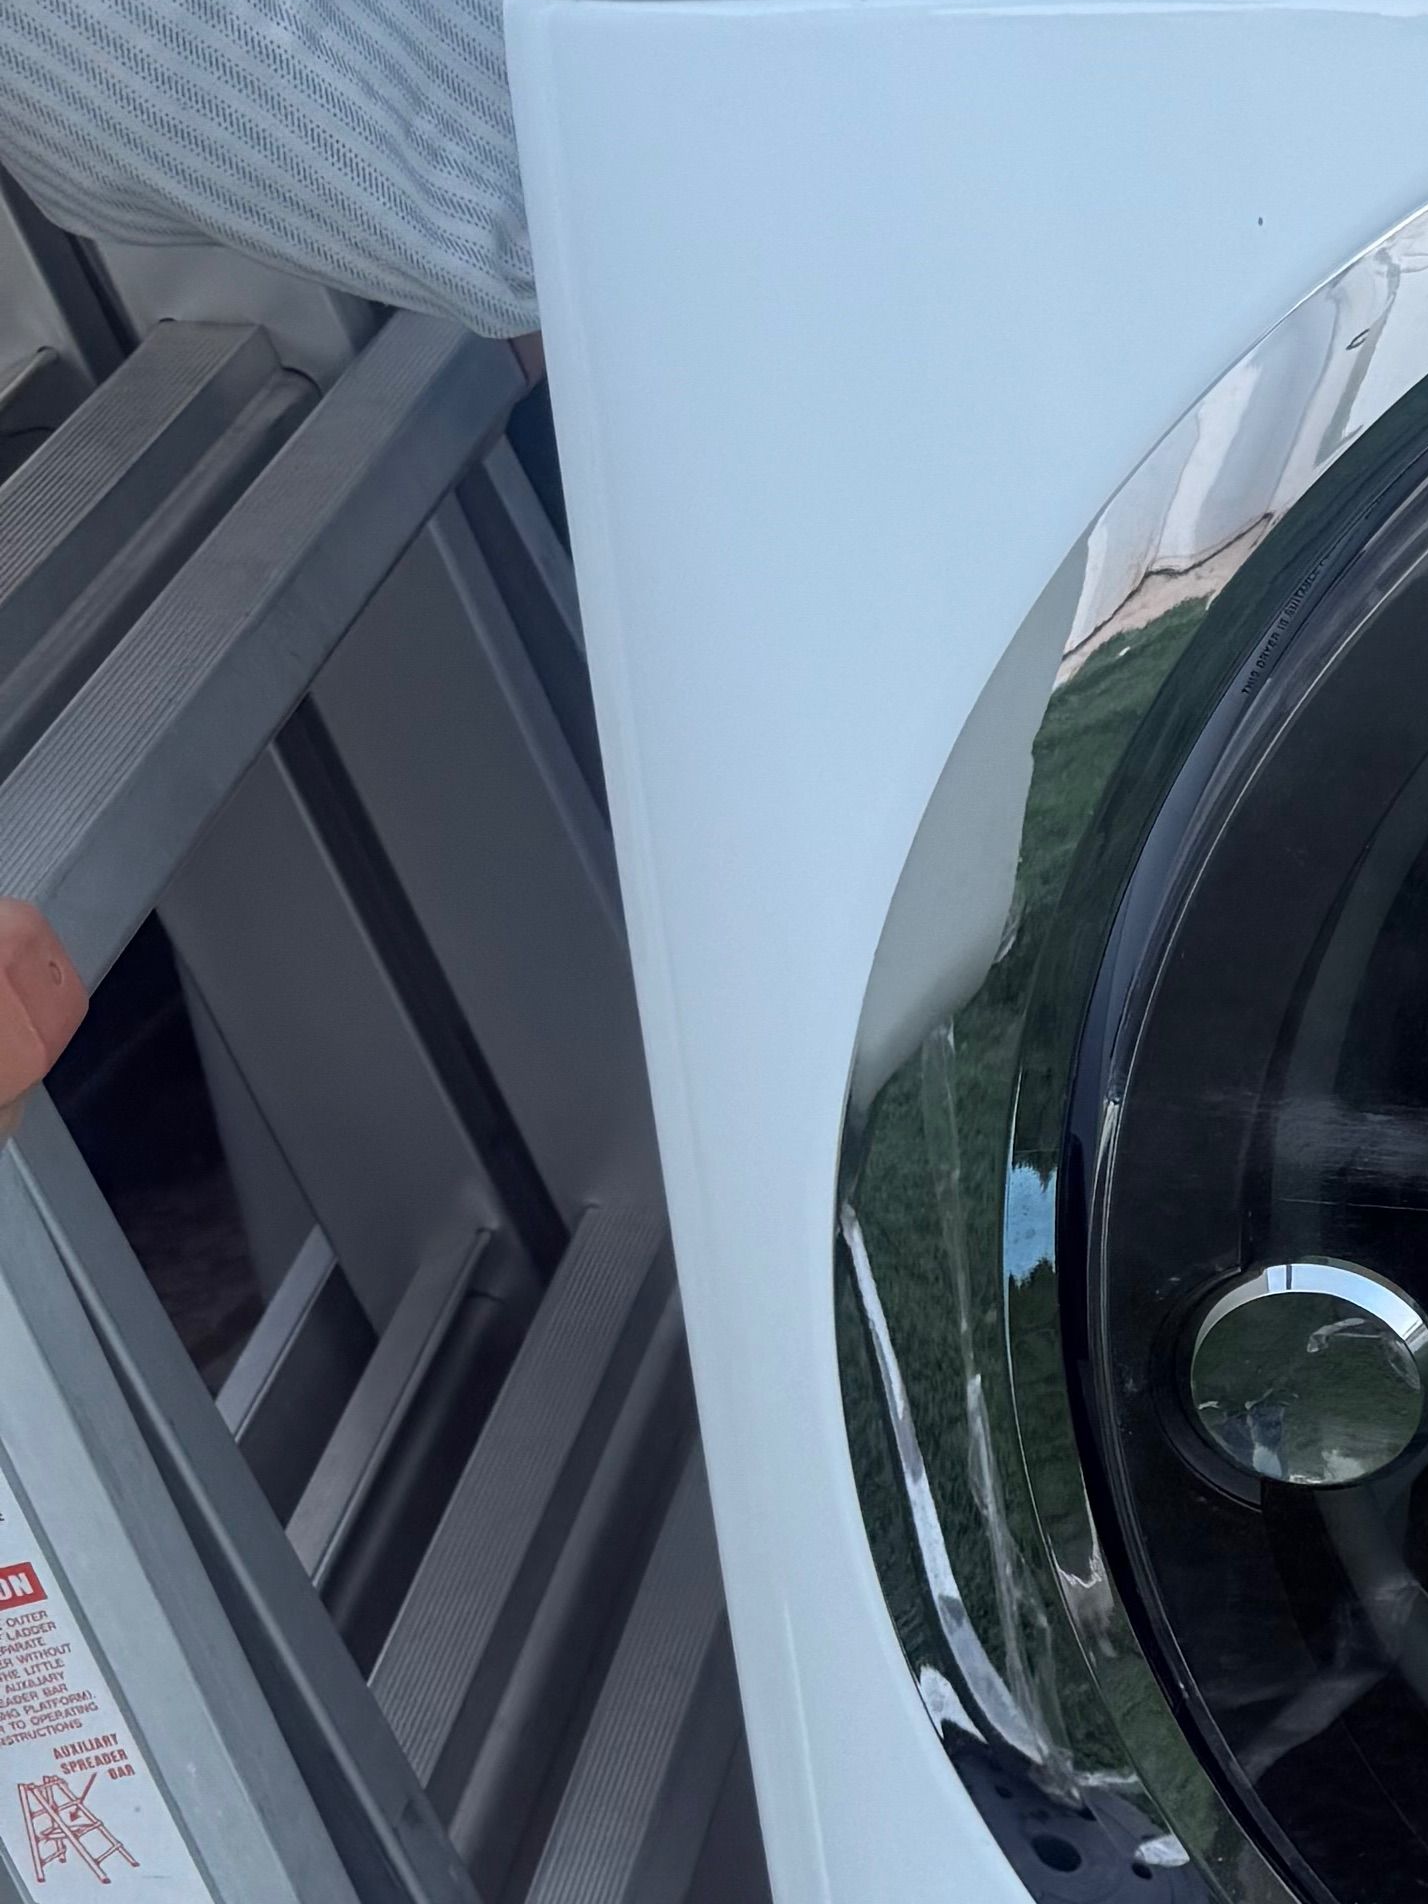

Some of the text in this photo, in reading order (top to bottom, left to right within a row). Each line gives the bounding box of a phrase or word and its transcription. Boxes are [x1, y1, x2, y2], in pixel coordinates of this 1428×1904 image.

[6, 1610, 48, 1627] OUTER
[6, 1621, 57, 1641] LADDER
[16, 1643, 72, 1664] WITHOUT
[24, 1658, 65, 1676] LITTLE
[42, 1683, 68, 1698] BAR
[8, 1719, 26, 1730] TO
[30, 1701, 99, 1726] OPERATING
[53, 1733, 119, 1760] AUXILIARY
[60, 1748, 128, 1775] SPREADER
[107, 1764, 135, 1781] BAR
